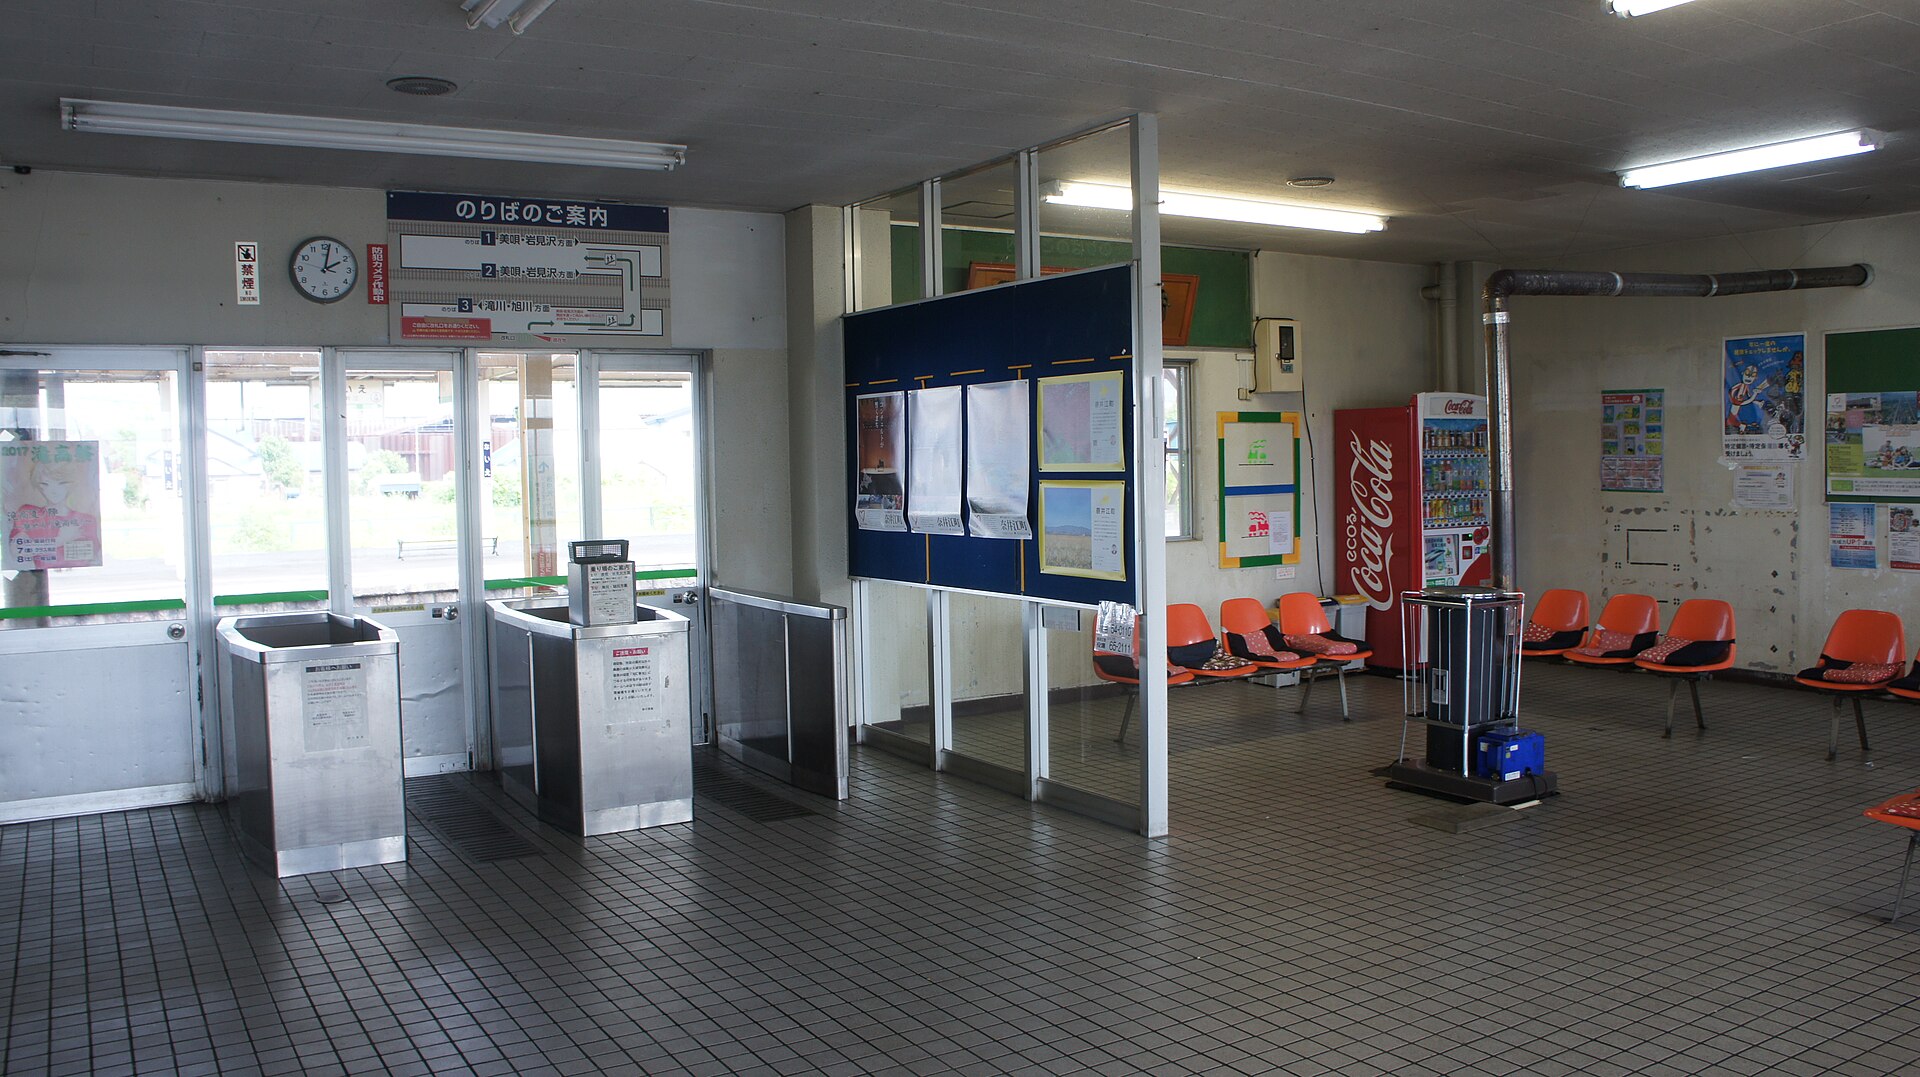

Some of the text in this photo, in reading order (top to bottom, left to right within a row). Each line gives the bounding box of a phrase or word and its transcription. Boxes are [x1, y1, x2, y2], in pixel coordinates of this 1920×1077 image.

[456, 200, 608, 226] のりばのご案内
[499, 234, 574, 247] 美唄・岩見沢方面
[241, 264, 255, 290] 禁煙
[372, 246, 384, 302] 防犯カメラ作動中
[499, 266, 575, 279] 美唄・岩見沢方面
[484, 300, 550, 312] 滝川・旭川方面
[1445, 400, 1474, 414] Coca-Cola
[2, 446, 29, 456] 2017
[1350, 429, 1394, 611] Coca-Cola
[1110, 641, 1130, 653] 65-2111
